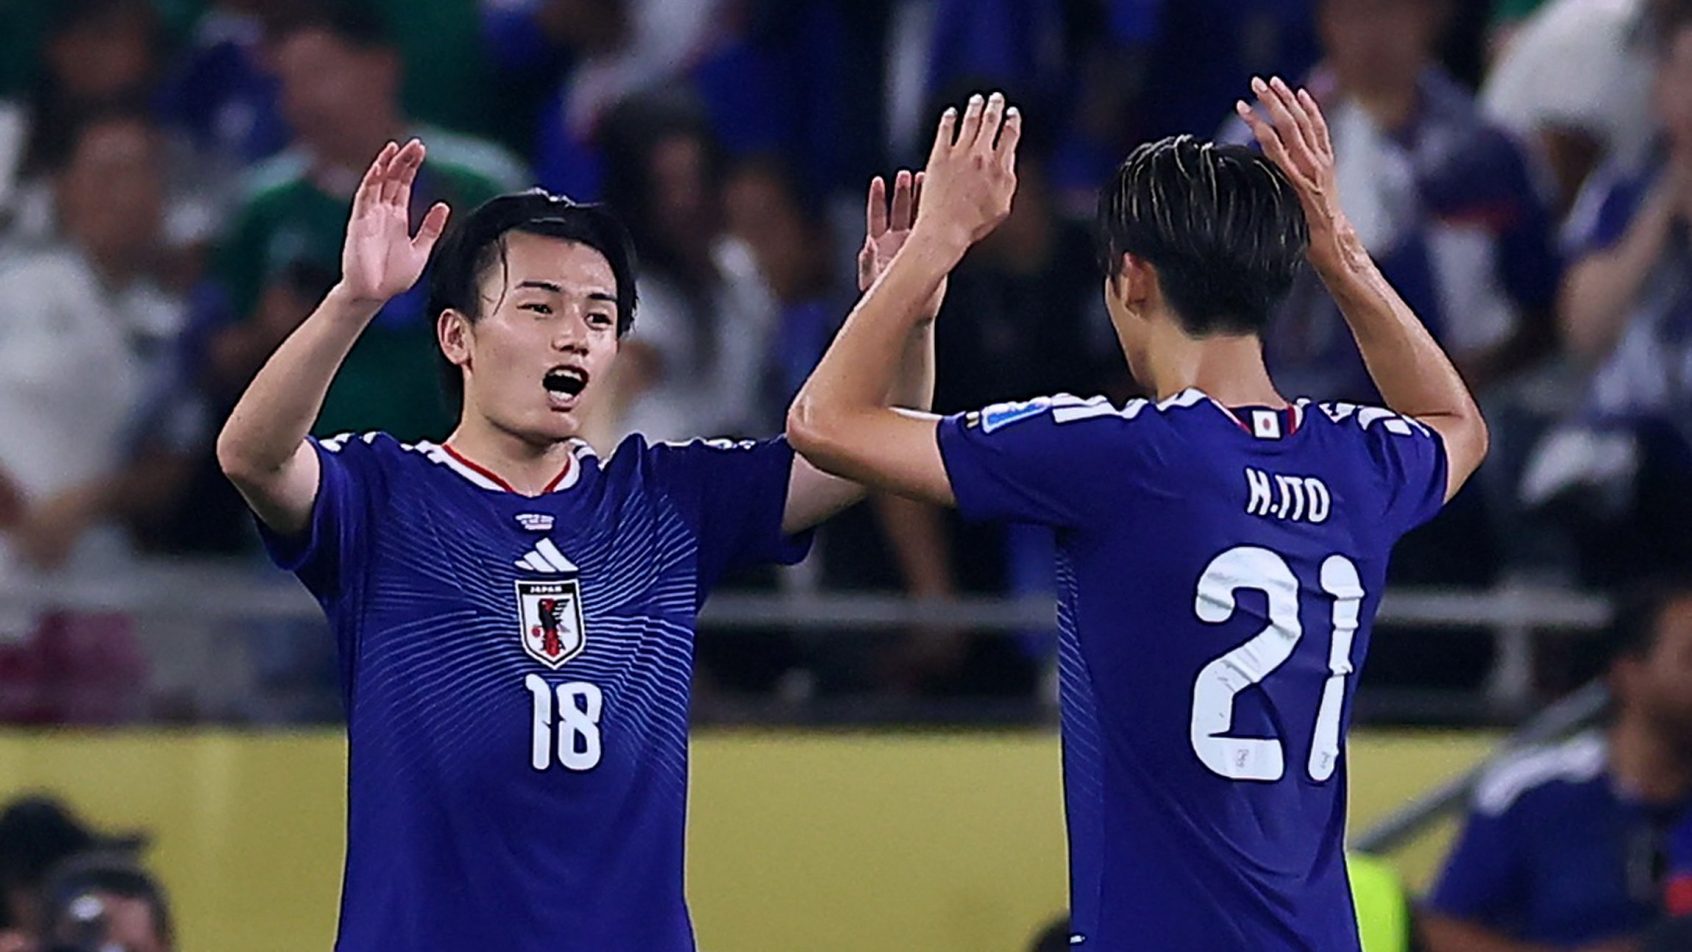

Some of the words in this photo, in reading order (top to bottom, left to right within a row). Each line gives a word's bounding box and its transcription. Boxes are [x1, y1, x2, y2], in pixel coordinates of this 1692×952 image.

[1245, 467, 1330, 523] H.ITO
[529, 585, 563, 594] JAPAN
[1190, 546, 1365, 782] 21
[525, 673, 603, 770] 18
